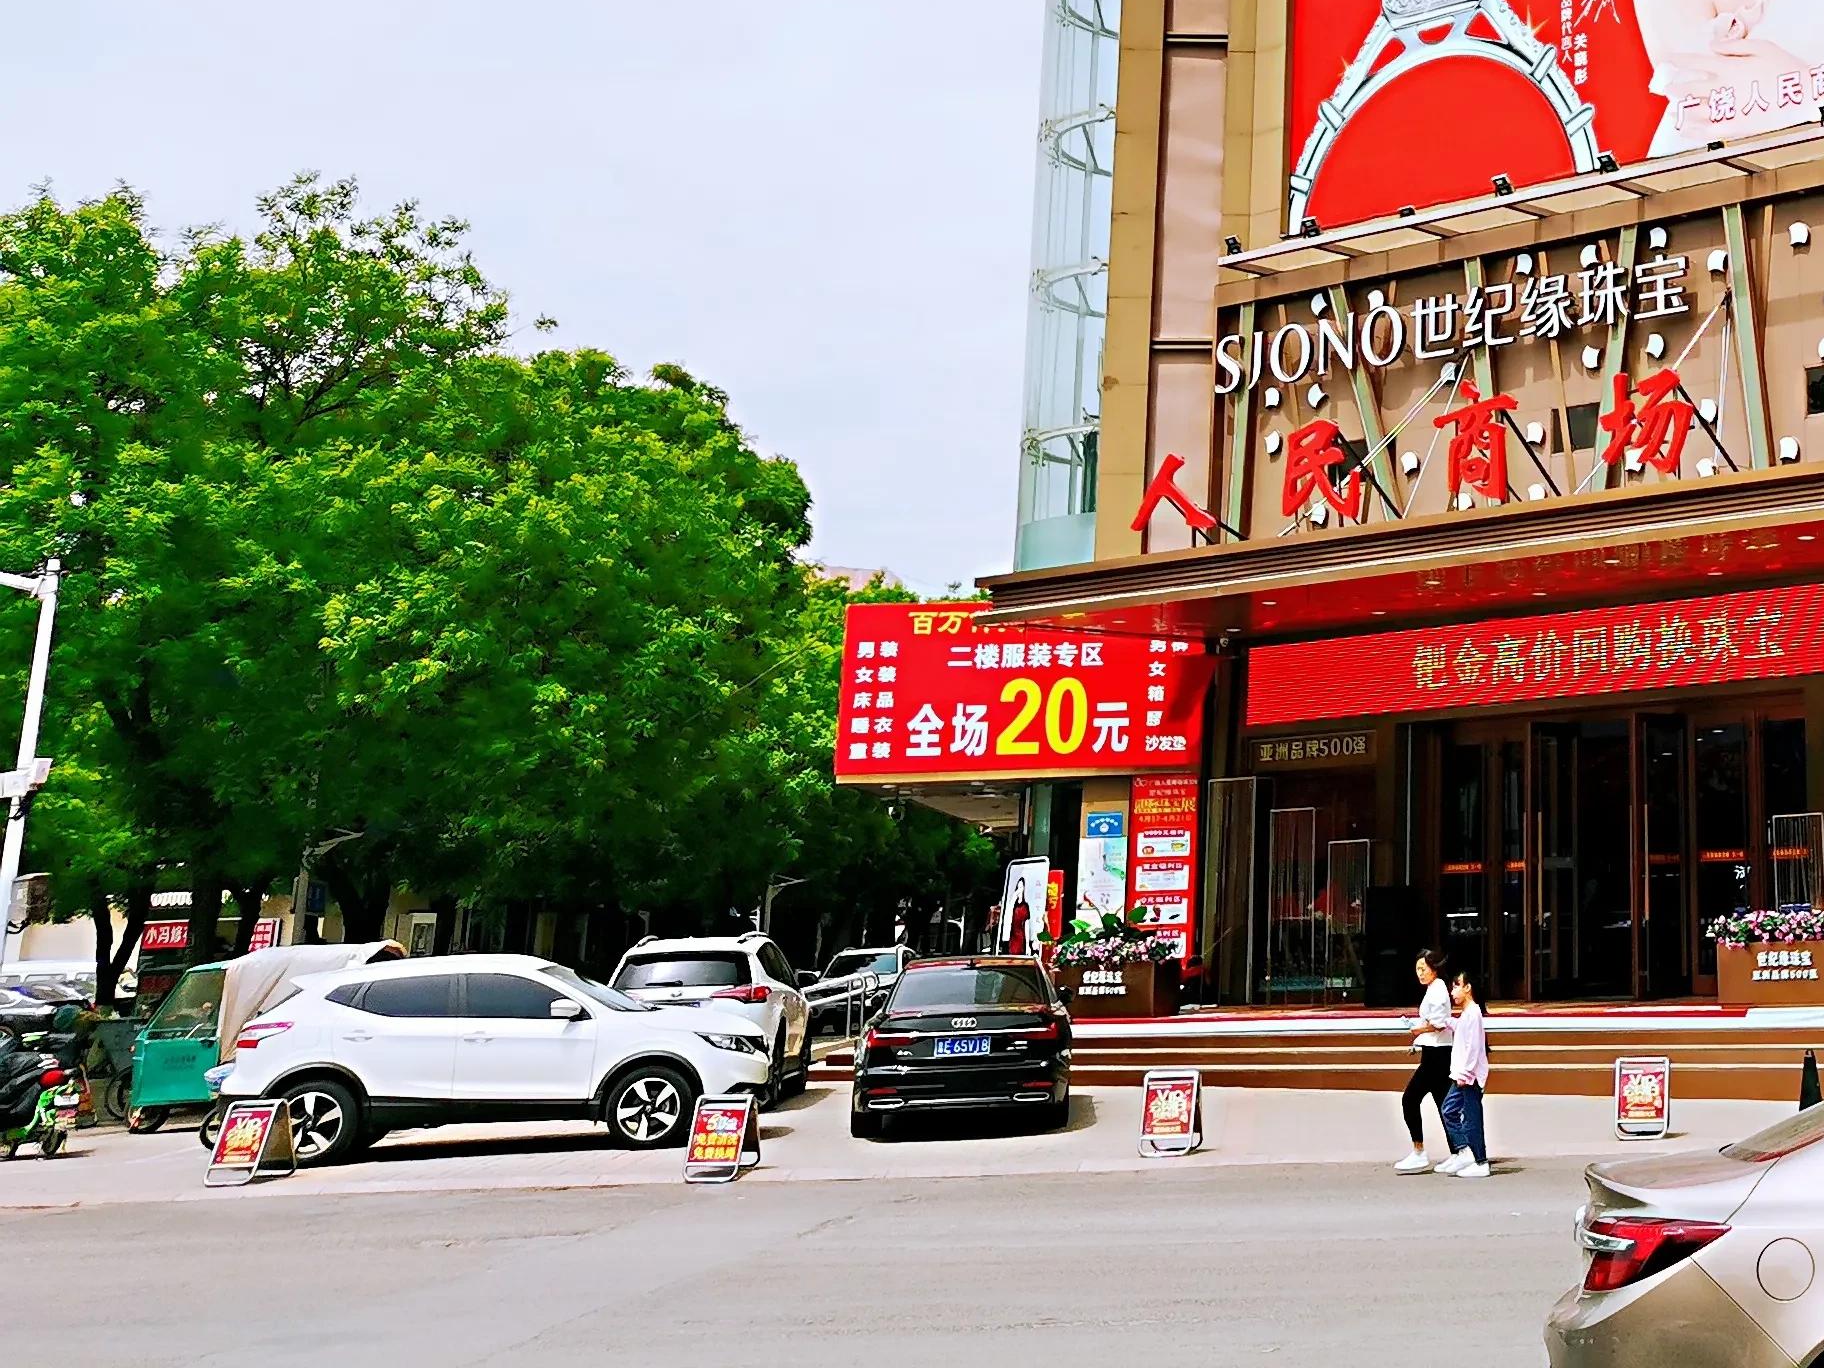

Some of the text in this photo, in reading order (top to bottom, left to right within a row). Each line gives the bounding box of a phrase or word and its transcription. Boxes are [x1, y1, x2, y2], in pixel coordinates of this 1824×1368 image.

[1130, 368, 1697, 533] 人民商场
[947, 641, 1104, 670] 二楼服装专区
[1259, 736, 1367, 762] 亚洲品牌500强
